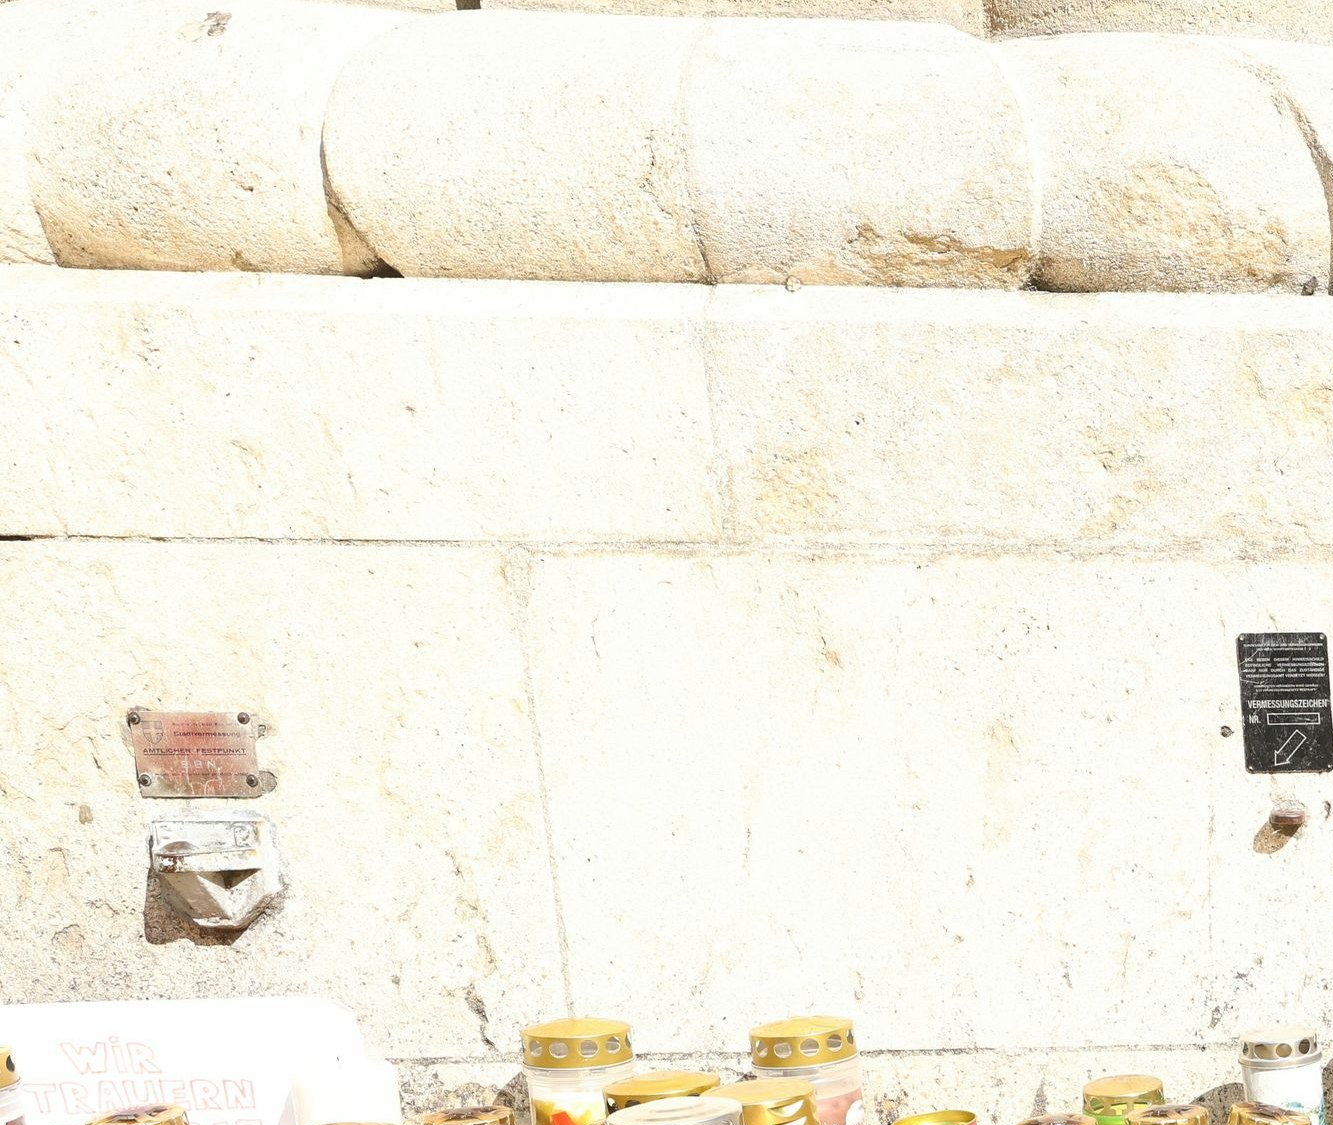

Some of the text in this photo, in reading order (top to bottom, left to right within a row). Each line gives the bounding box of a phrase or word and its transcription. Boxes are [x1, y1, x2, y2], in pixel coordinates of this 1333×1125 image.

[1247, 699, 1328, 709] VERMESSUNGSZEICHEN
[1248, 715, 1262, 724] NR.
[23, 1078, 258, 1115] TRAUERN
